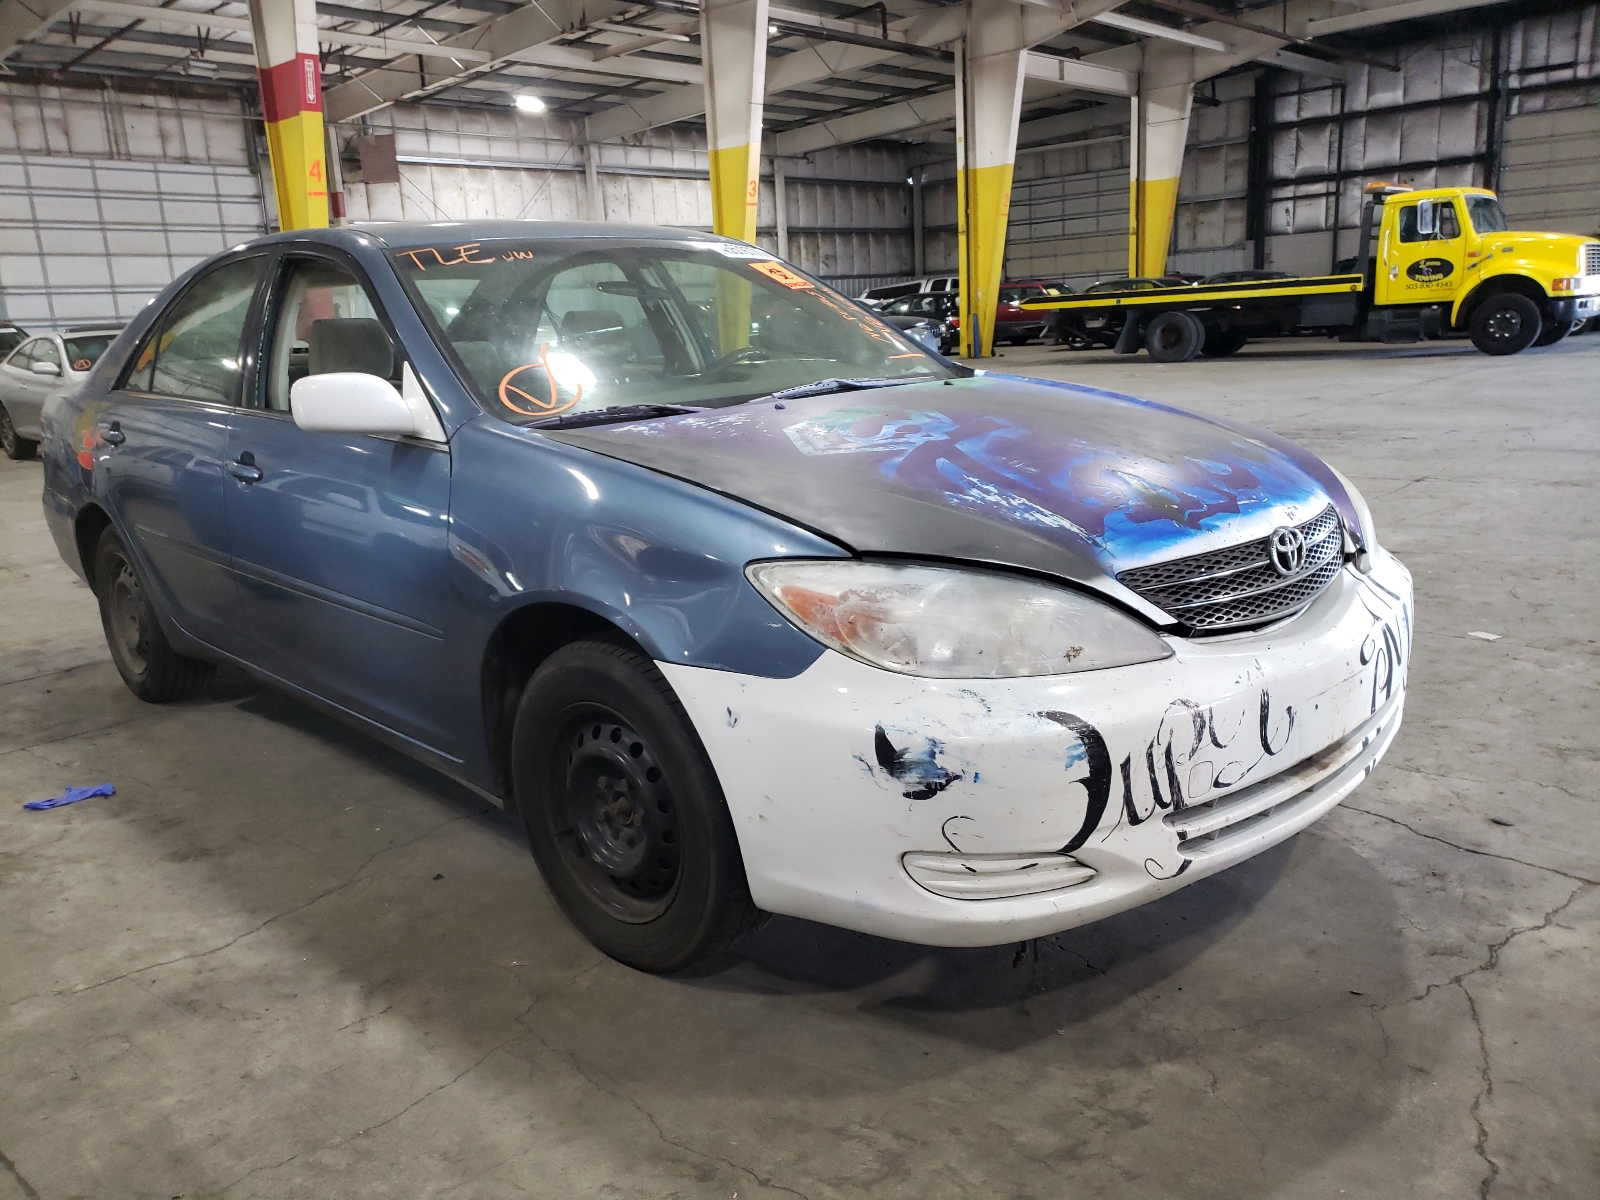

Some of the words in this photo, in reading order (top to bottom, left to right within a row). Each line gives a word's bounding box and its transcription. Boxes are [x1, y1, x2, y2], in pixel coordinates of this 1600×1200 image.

[309, 159, 322, 183] 4
[748, 180, 757, 198] 3
[395, 243, 496, 271] TLE
[1414, 272, 1444, 282] TOWING
